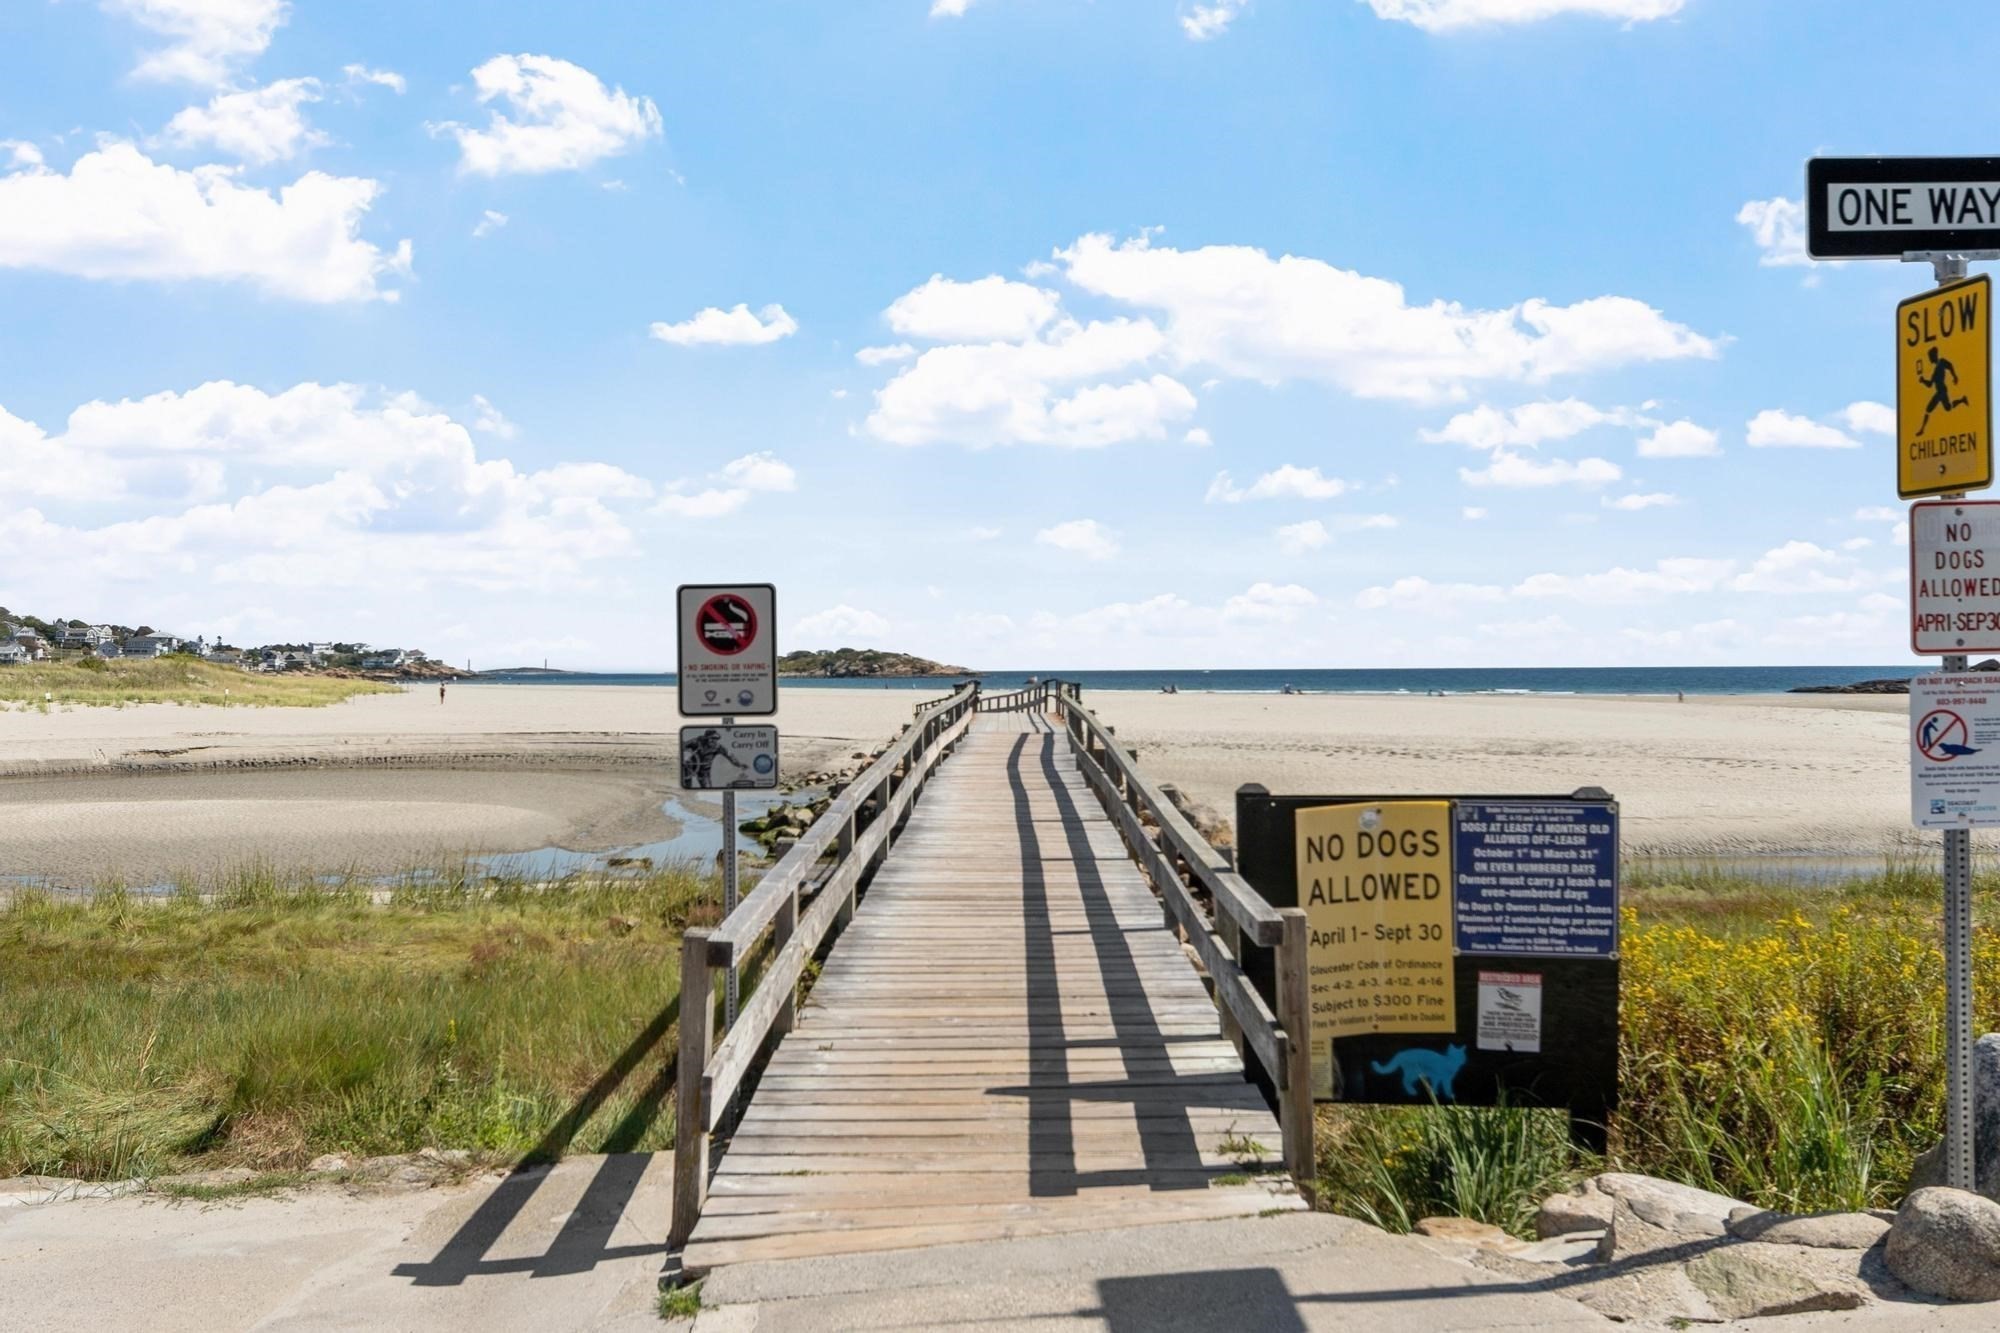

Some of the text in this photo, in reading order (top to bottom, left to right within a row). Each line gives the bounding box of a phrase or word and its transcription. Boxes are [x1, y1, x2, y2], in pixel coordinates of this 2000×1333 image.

[1838, 187, 2000, 226] ONE WAY
[1906, 292, 1978, 347] SLOW
[1909, 432, 1977, 461] CHILDREN
[1946, 523, 1972, 542] NO
[1935, 549, 1984, 570] DOGS
[1919, 578, 2000, 597] ALLOWED
[701, 663, 728, 671] SMOKING
[1929, 677, 1942, 685] NOT
[733, 731, 755, 739] Carry
[731, 740, 769, 750] Carry Off
[1460, 822, 1610, 834] DOGS AT LEAST 4 MONTHS OLD
[1306, 829, 1441, 864] NO DOGS
[1483, 834, 1587, 845] ALLOWED OFF-LEASH
[1473, 848, 1513, 858] October
[1530, 848, 1541, 859] to
[1543, 848, 1577, 859] March
[1473, 862, 1597, 874] ON EVEN NUMBERED DAYS
[1308, 873, 1441, 906] ALLOWED
[1458, 874, 1612, 888] Owners must carry a leash on
[1480, 888, 1589, 901] even-numbered days
[1471, 902, 1492, 912] Dogs
[1539, 903, 1573, 913] Allowed
[1310, 927, 1346, 949] April
[1374, 923, 1412, 944] Sept
[1418, 923, 1442, 941] 30
[1310, 959, 1443, 976] Gloucester Code of Ordinance
[1311, 984, 1329, 994] Sec
[1417, 976, 1444, 987] 4-16
[1312, 994, 1445, 1014] Subject to $300 Fine
